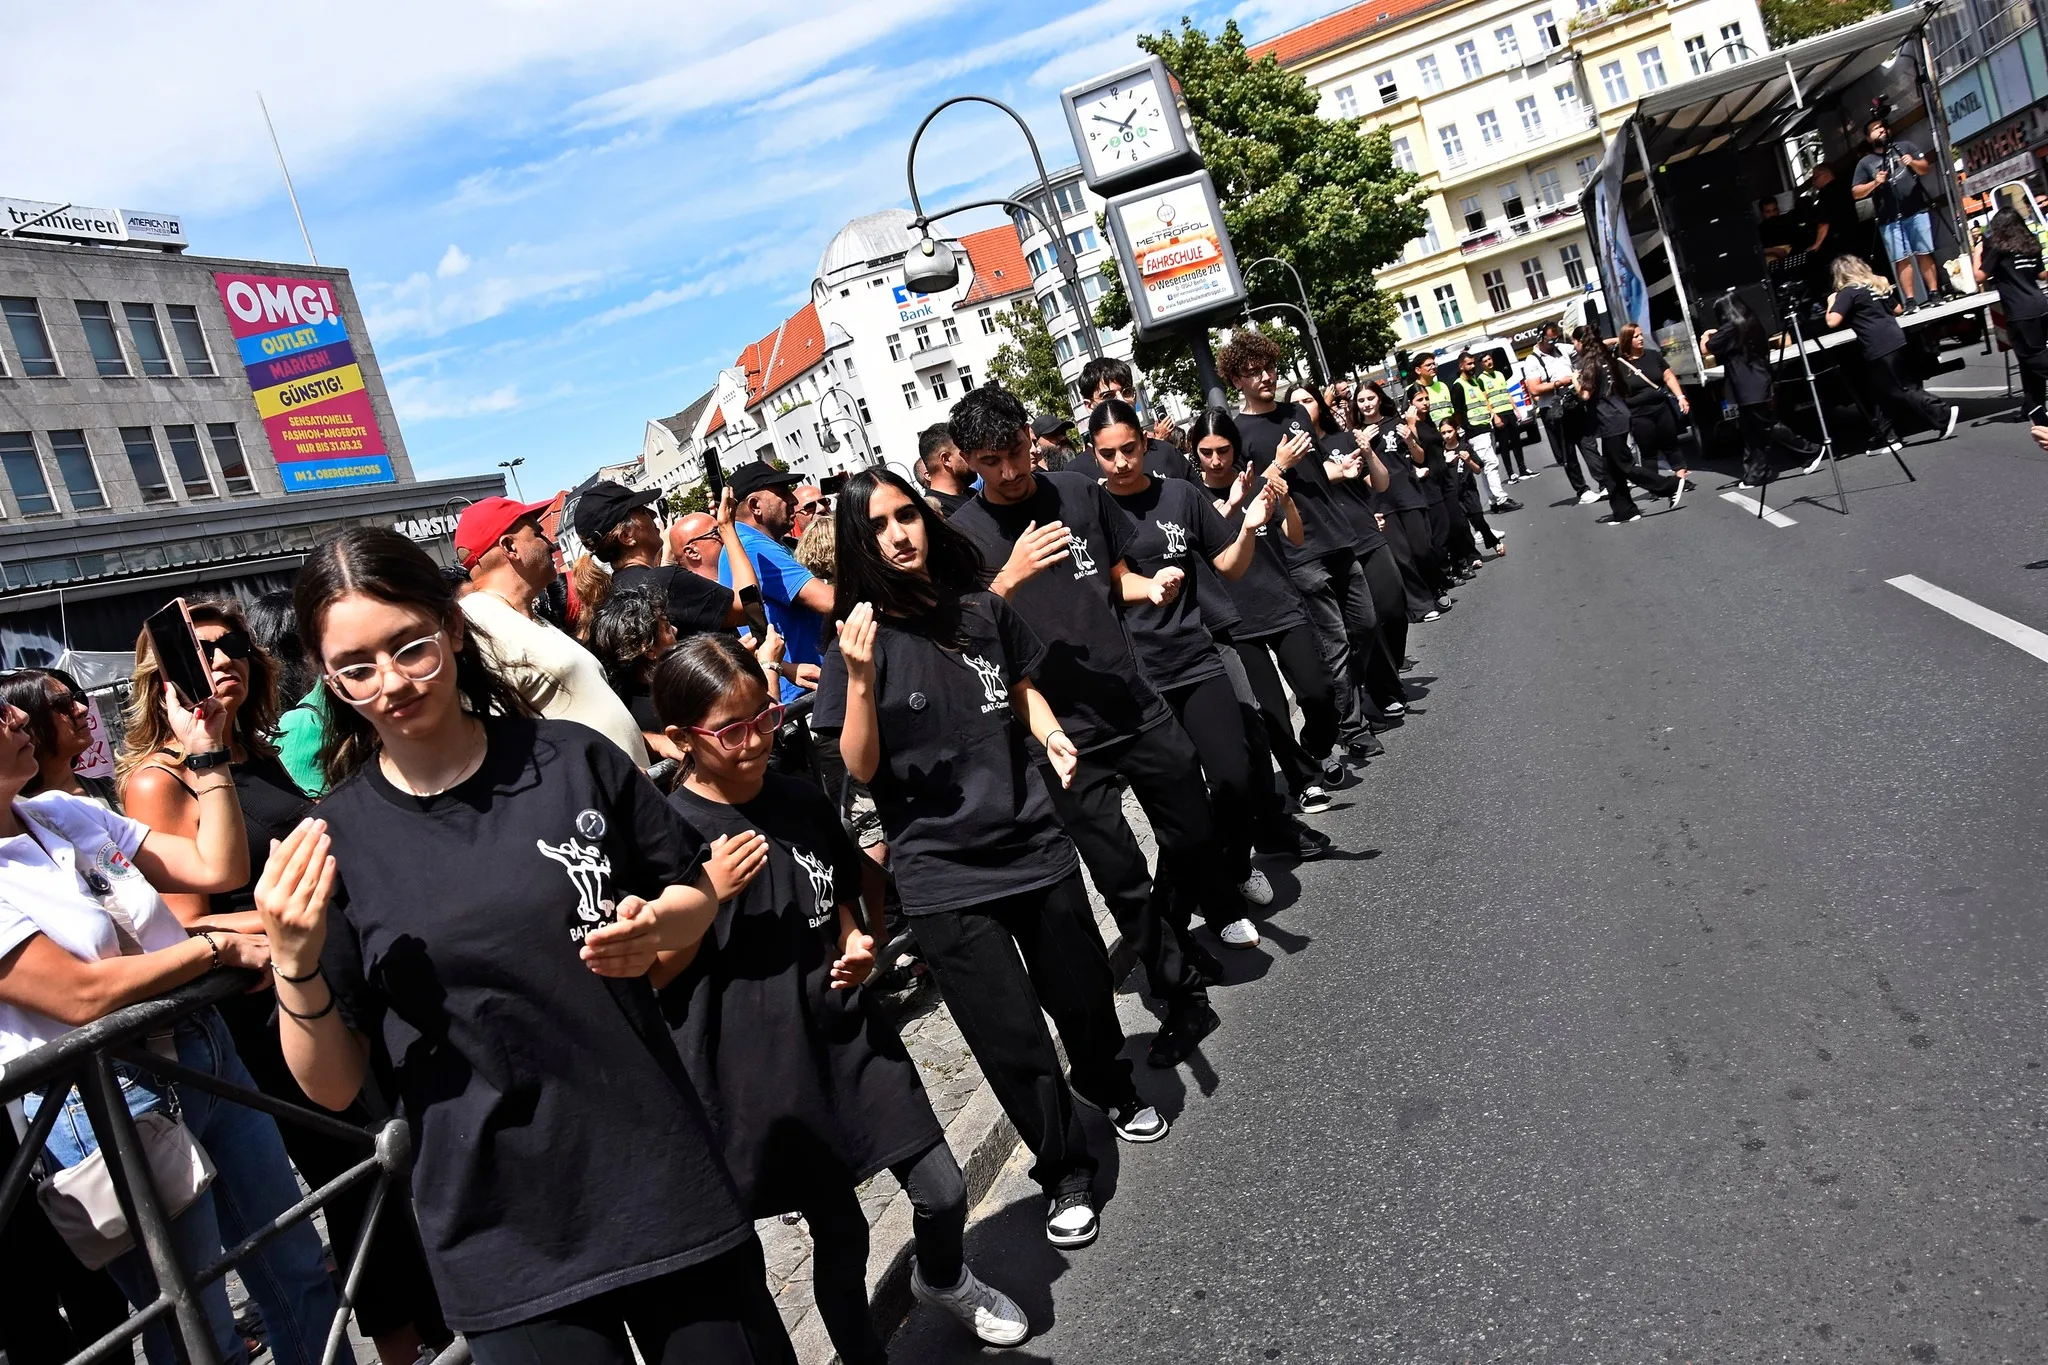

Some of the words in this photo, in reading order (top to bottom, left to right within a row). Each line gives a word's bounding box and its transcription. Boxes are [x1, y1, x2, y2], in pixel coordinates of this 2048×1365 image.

[1109, 87, 1119, 96] 12
[1153, 108, 1159, 117] 3
[1090, 132, 1096, 141] 9
[1131, 152, 1138, 161] 6
[8, 206, 119, 234] trainieren
[128, 217, 169, 229] AMERICAN
[1136, 222, 1209, 247] METROPOL
[1147, 245, 1203, 272] FAHRSCHULE
[1156, 268, 1207, 290] Weserstraße
[1208, 262, 1221, 276] 213
[227, 281, 338, 325] OMG!
[900, 304, 933, 322] Bank
[261, 327, 319, 355] OUTLET!
[269, 350, 332, 380] MARKEN!
[279, 375, 344, 407] GÜNSTIG!
[288, 414, 354, 427] SENSATIONELLE
[282, 426, 368, 441] FASHION-ANGEBOTE
[296, 442, 315, 454] NUR
[315, 441, 330, 452] BIS
[329, 440, 363, 452] 31.05.25
[294, 470, 307, 482] IM
[306, 469, 316, 481] 2.
[316, 464, 381, 480] OBERGESCHOSS
